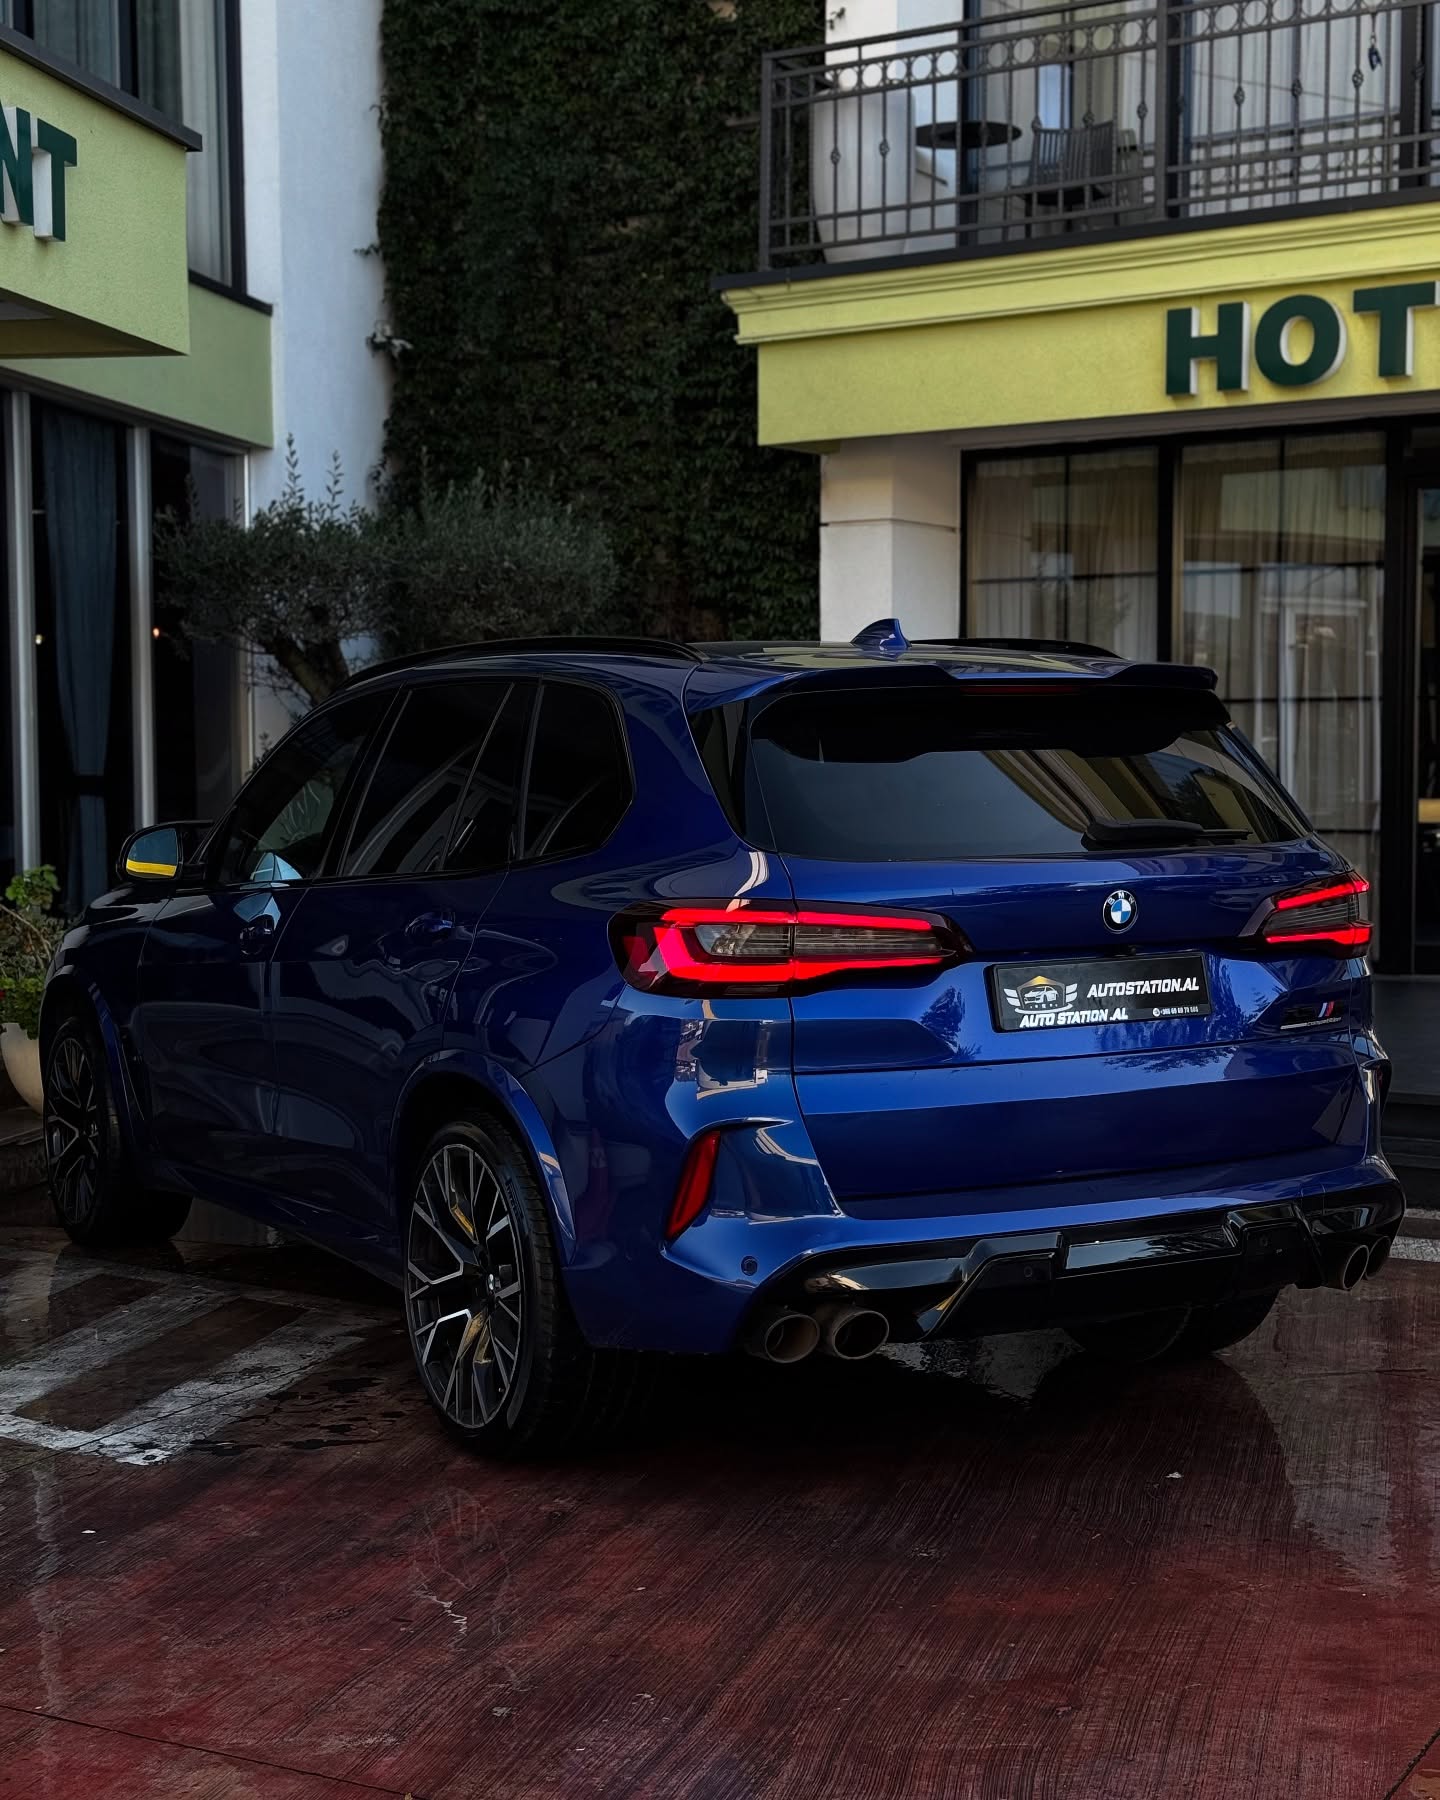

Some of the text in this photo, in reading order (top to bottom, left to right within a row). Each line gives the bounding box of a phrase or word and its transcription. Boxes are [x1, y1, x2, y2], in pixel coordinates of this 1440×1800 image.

[1165, 281, 1440, 396] HOT
[1087, 977, 1200, 999] AUTOSTATION.AL
[1019, 1013, 1056, 1028] AUTO
[1056, 1009, 1109, 1025] STATION
